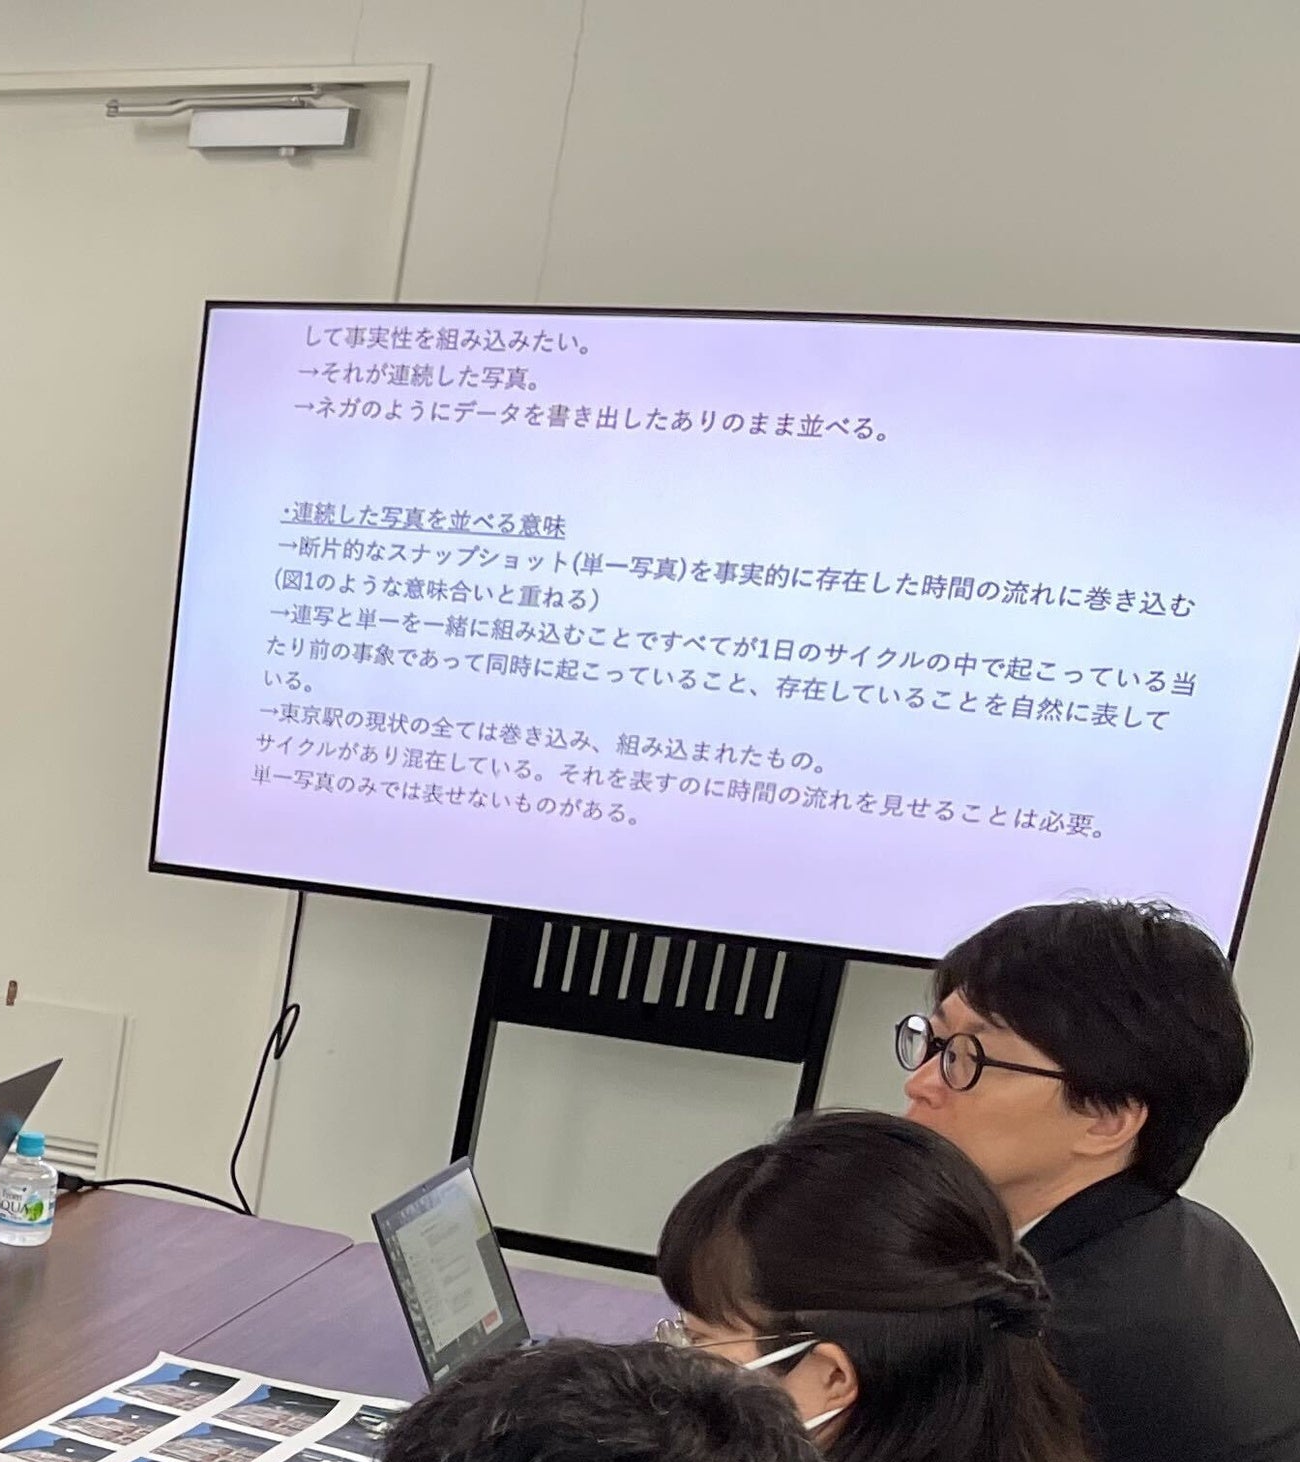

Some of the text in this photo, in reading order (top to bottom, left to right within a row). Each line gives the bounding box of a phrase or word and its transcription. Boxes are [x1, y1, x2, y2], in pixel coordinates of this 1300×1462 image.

[305, 325, 589, 356] して事実性を組み込みたい。
[320, 362, 537, 391] それが連続した写真。
[263, 669, 313, 694] いる。
[251, 764, 637, 826] 単一写真のみでは表せないものがある。
